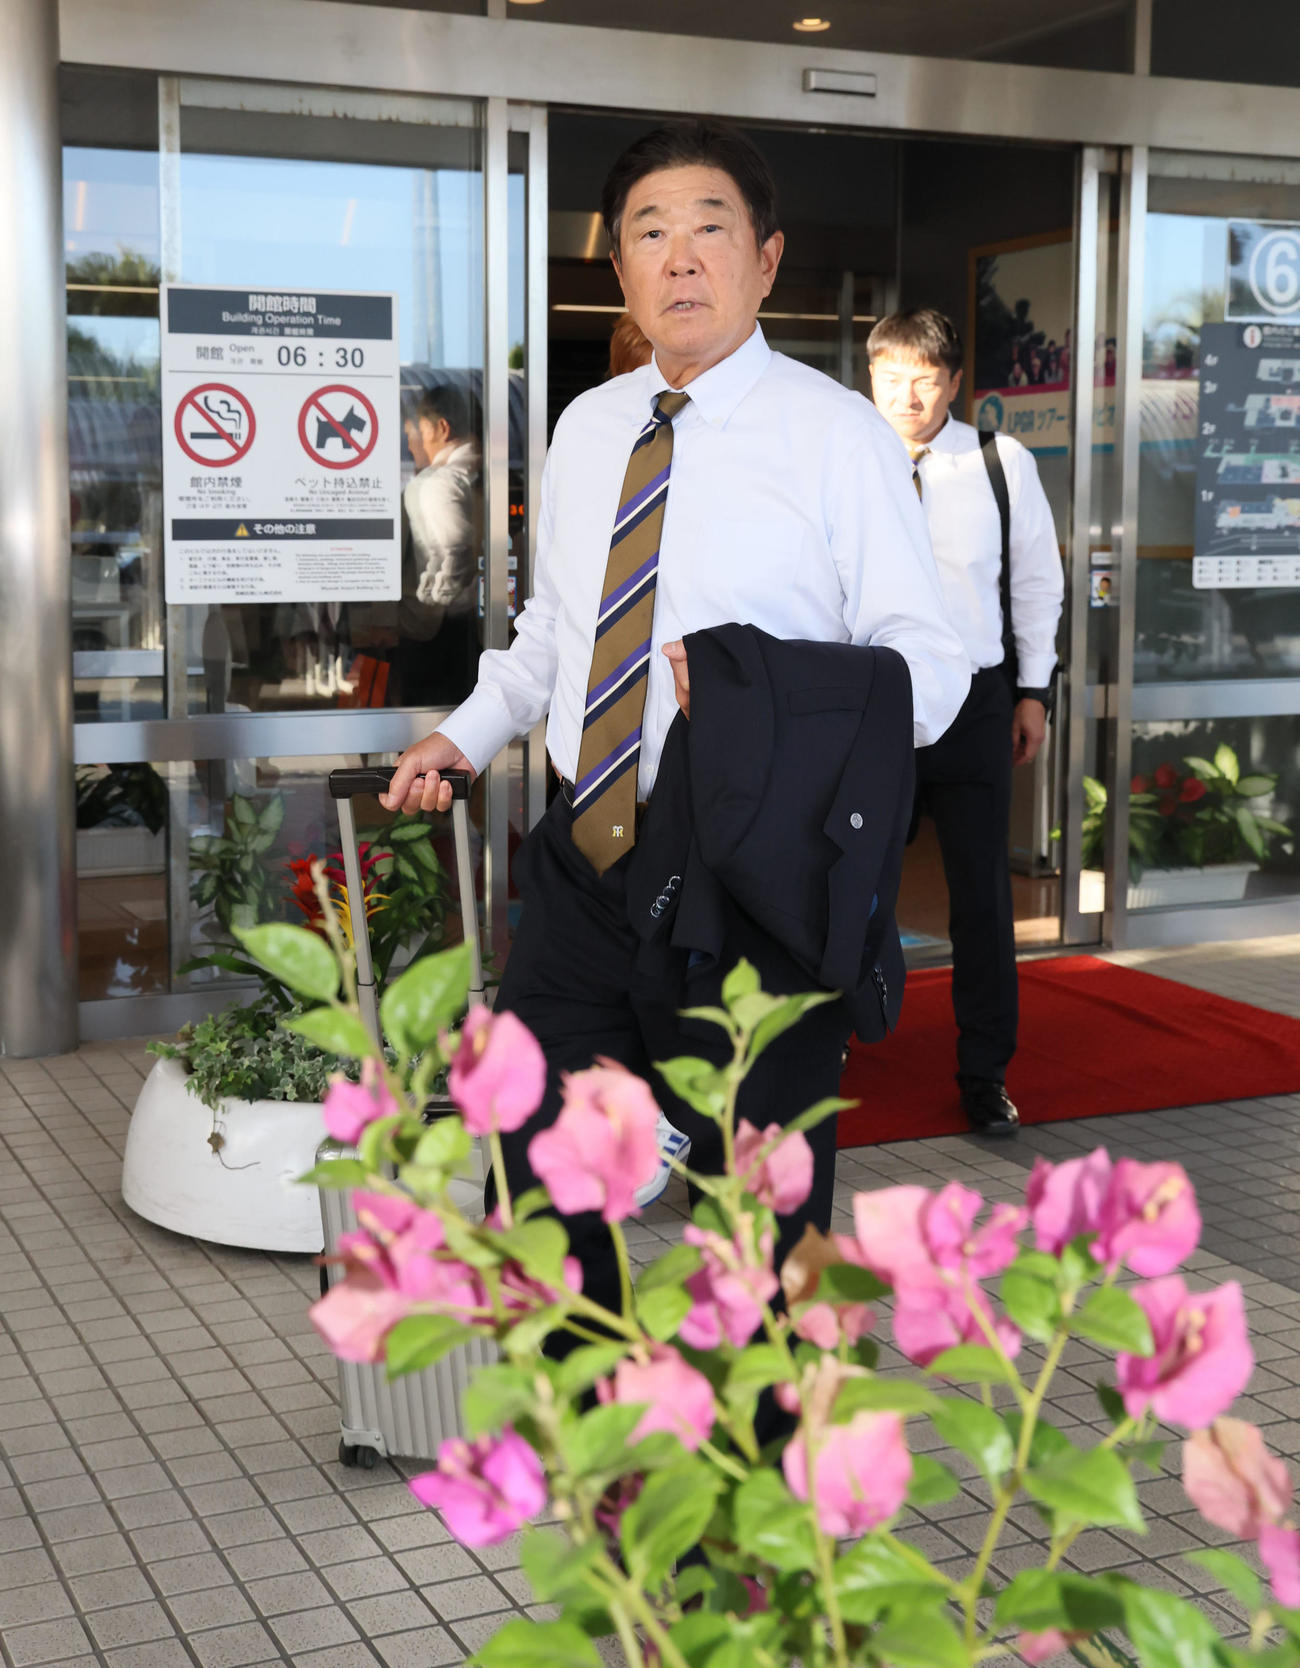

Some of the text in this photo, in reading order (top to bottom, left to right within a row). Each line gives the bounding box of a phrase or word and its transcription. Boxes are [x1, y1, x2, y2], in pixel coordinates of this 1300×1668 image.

[248, 294, 317, 314] 開館時間
[221, 311, 342, 327] Building Operation Time
[229, 343, 256, 354] Open
[190, 476, 243, 488] 館内禁煙
[294, 477, 383, 489] ペット持込禁止
[252, 523, 317, 535] その他の注意
